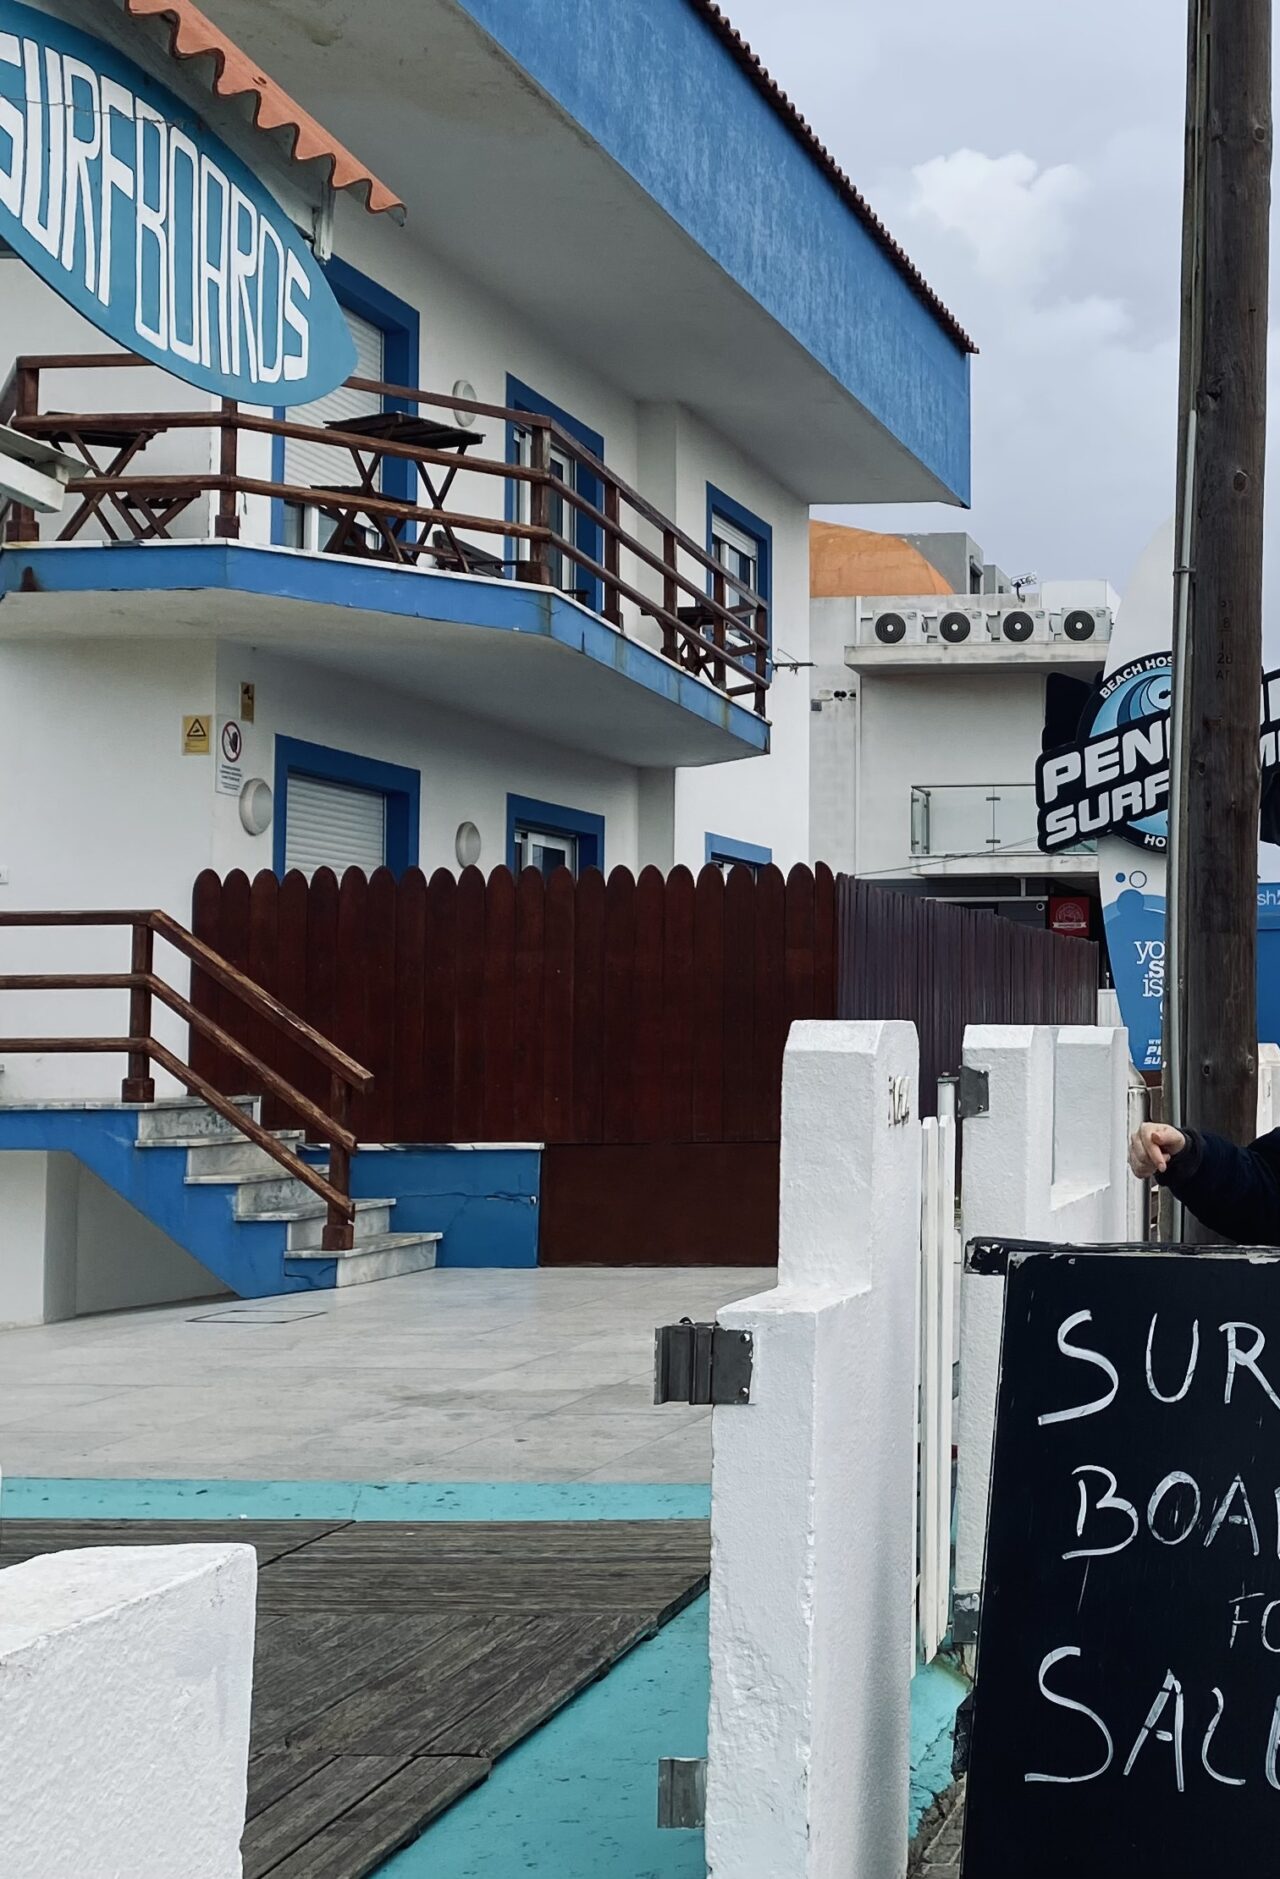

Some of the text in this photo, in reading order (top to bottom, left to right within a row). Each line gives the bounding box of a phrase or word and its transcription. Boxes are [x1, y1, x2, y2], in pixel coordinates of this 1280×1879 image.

[0, 31, 310, 384] SURFBOARDS
[1100, 663, 1143, 699] BEACH
[1046, 769, 1170, 846] SURF
[1142, 973, 1164, 997] is
